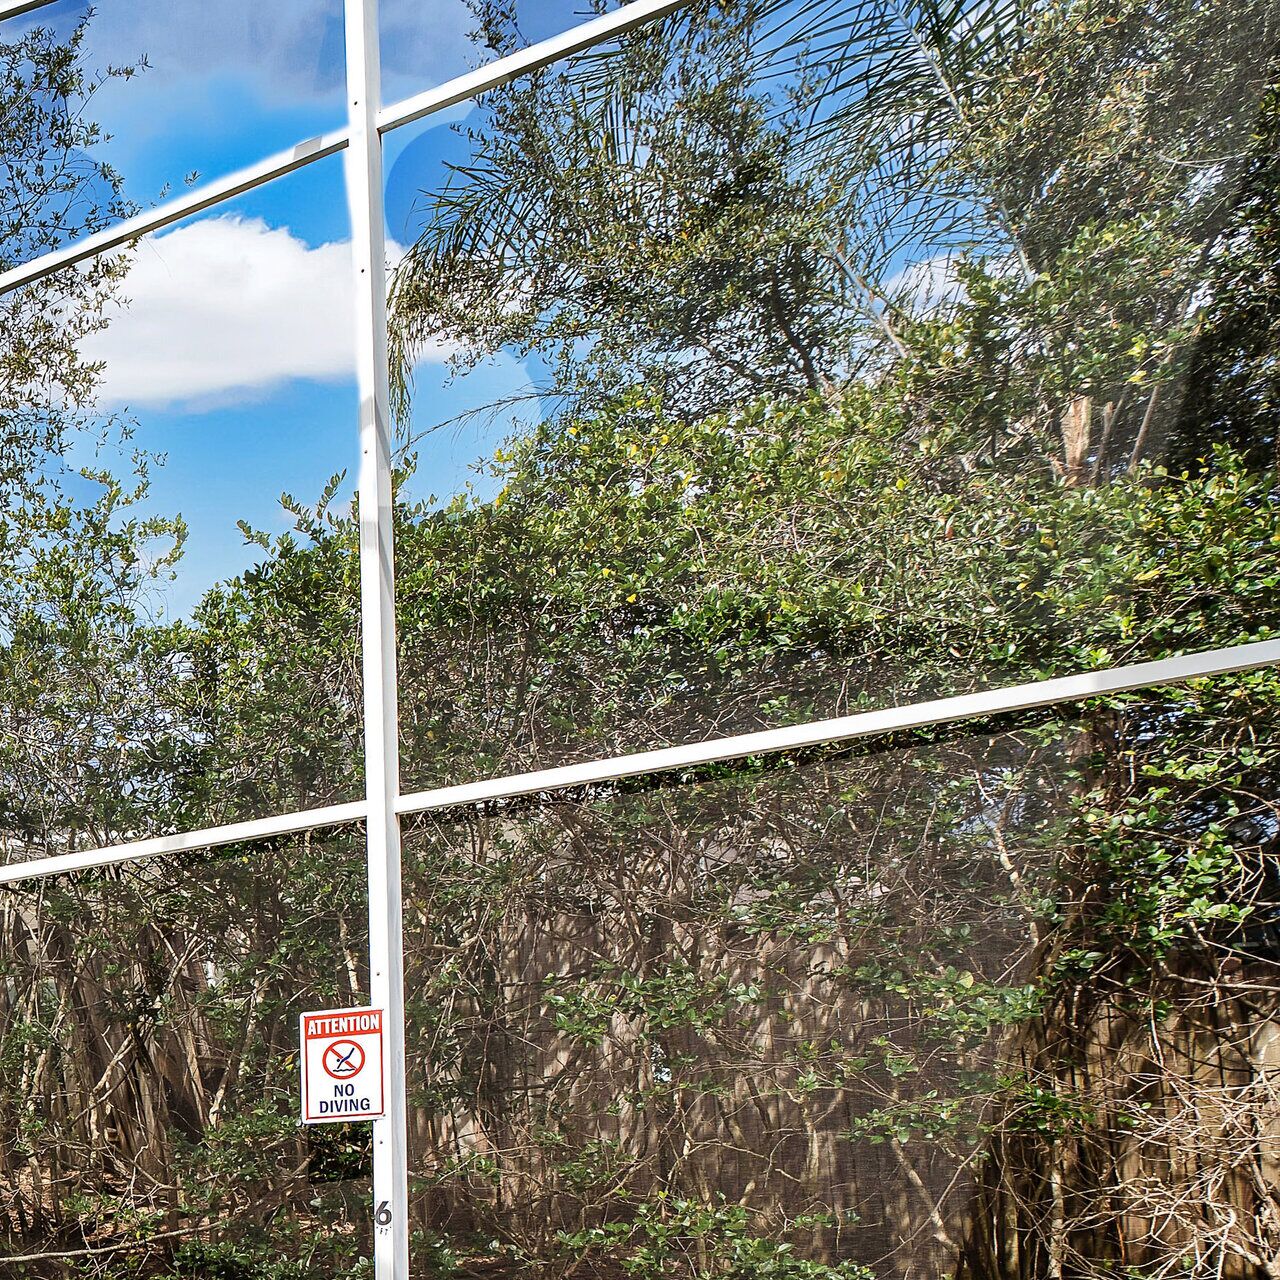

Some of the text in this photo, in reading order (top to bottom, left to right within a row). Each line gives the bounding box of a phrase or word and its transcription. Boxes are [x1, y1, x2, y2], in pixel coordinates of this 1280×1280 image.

[308, 1014, 380, 1036] ATTENTION
[334, 1083, 355, 1097] NO
[319, 1098, 371, 1114] DIVING
[375, 1201, 392, 1225] 6
